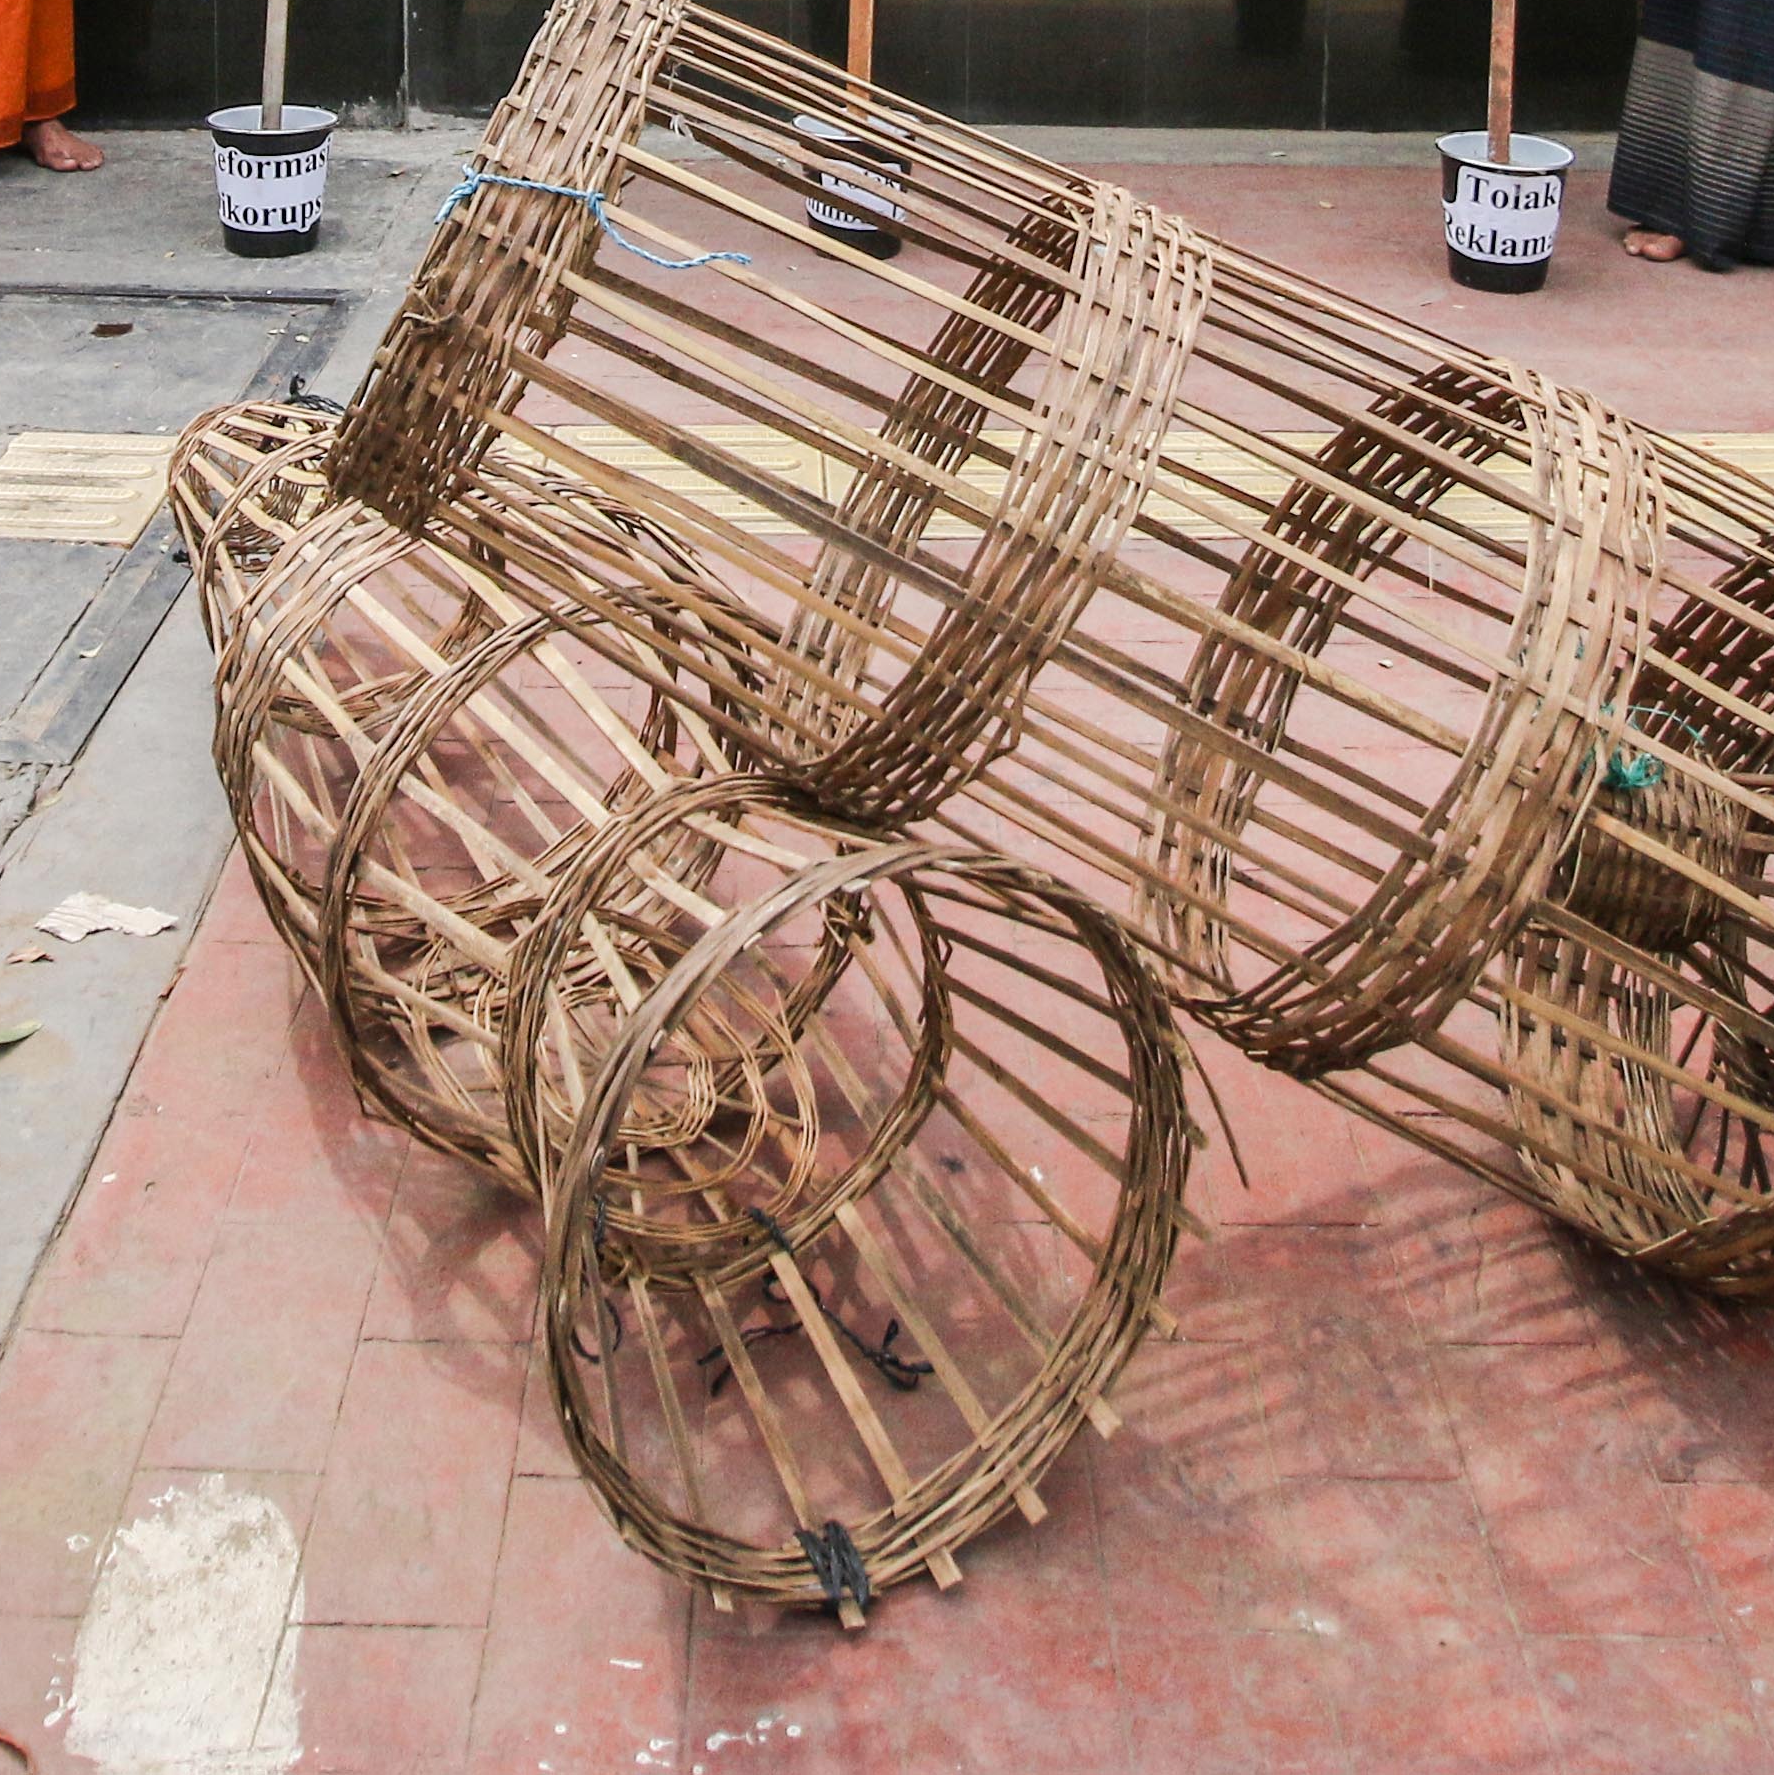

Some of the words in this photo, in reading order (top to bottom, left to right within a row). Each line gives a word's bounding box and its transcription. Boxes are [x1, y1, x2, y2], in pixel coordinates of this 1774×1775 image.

[213, 137, 332, 179] eformasi
[222, 193, 322, 227] ikorups
[1466, 174, 1558, 210] Tolak
